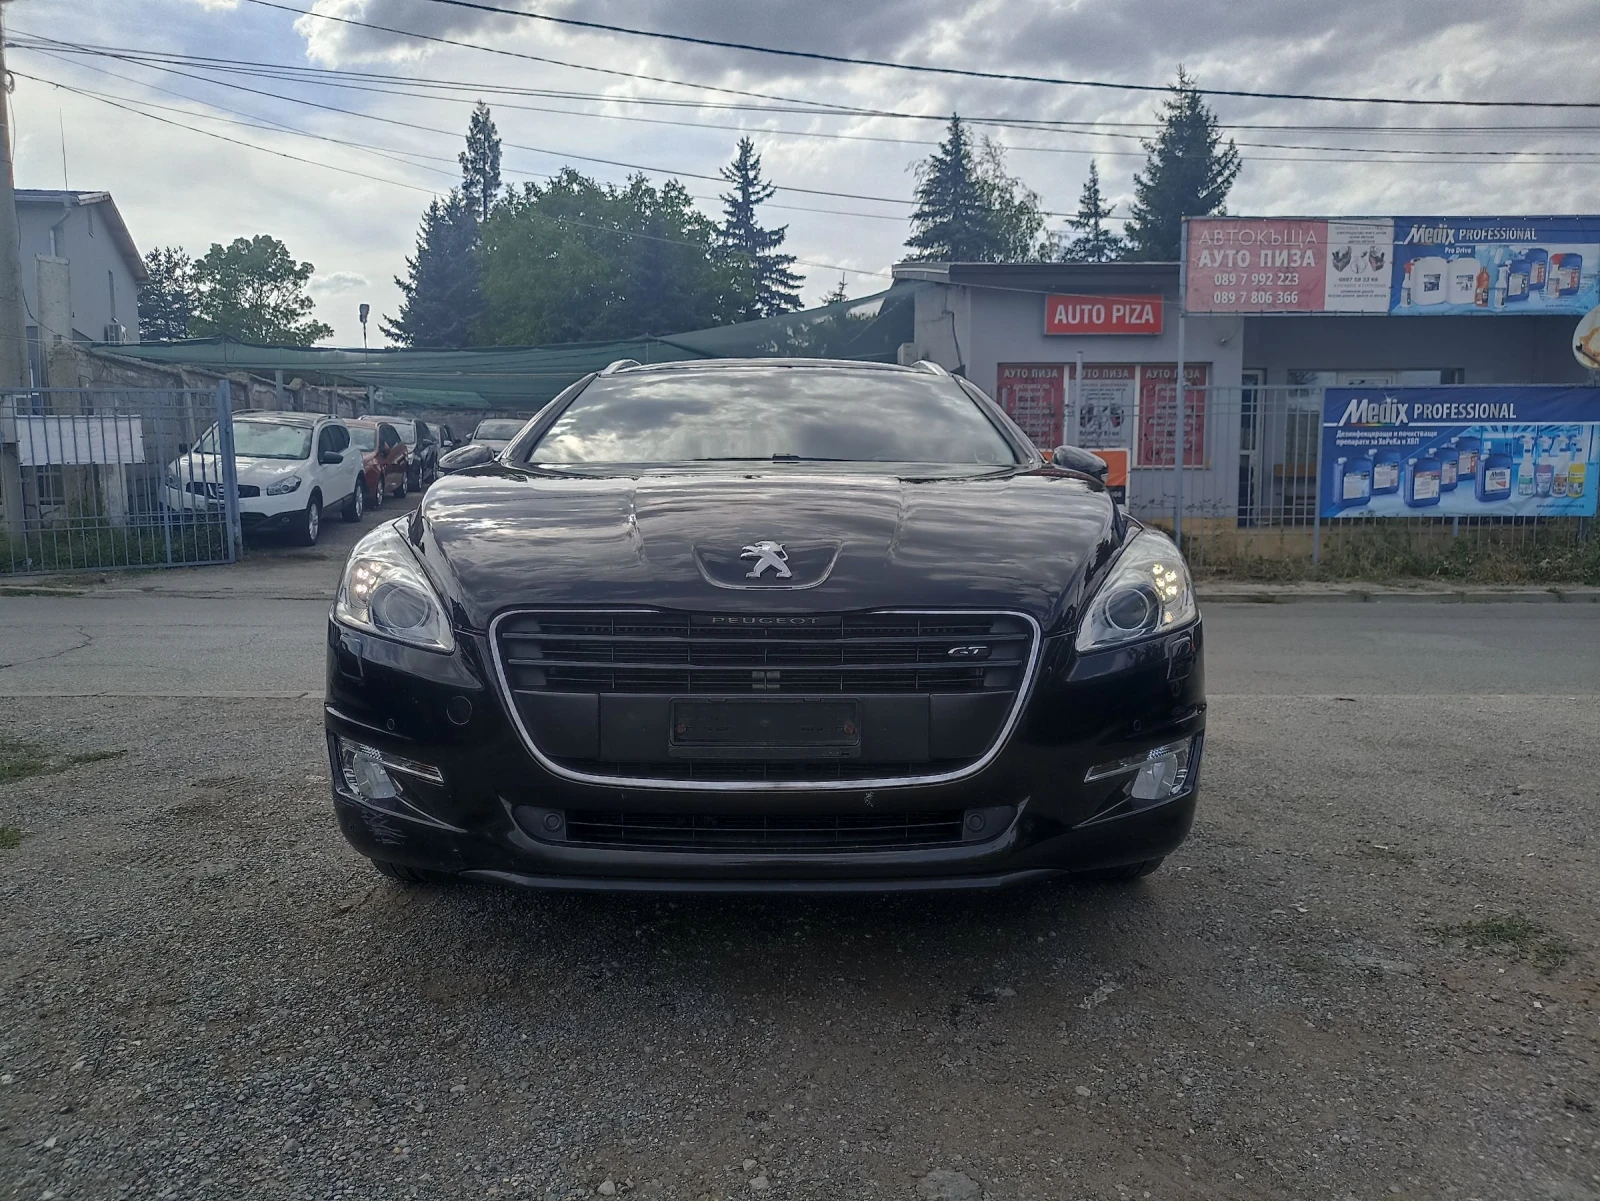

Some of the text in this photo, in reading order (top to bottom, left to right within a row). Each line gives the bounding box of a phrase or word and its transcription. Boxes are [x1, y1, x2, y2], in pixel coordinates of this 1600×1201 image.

[1198, 229, 1318, 248] АВТОКЪЩА
[1404, 223, 1538, 244] Medix PROFESSIONAL
[1444, 246, 1472, 254] Pro Drive
[1198, 249, 1316, 268] АУТО ПИЗА
[1213, 272, 1299, 286] 089 7 992 223
[1213, 290, 1299, 304] 089 7 806 366
[1054, 304, 1154, 324] AUTO PIZA
[1004, 368, 1058, 378] АУТО ПИЗА
[1102, 368, 1129, 379] ПИЗА
[1145, 369, 1171, 379] АУТО
[1338, 397, 1516, 426] Medix PROFESSIONAL
[1398, 430, 1438, 438] почистващи
[1336, 438, 1370, 446] препарати
[711, 617, 820, 625] PEUGEOT
[947, 646, 988, 657] GT
